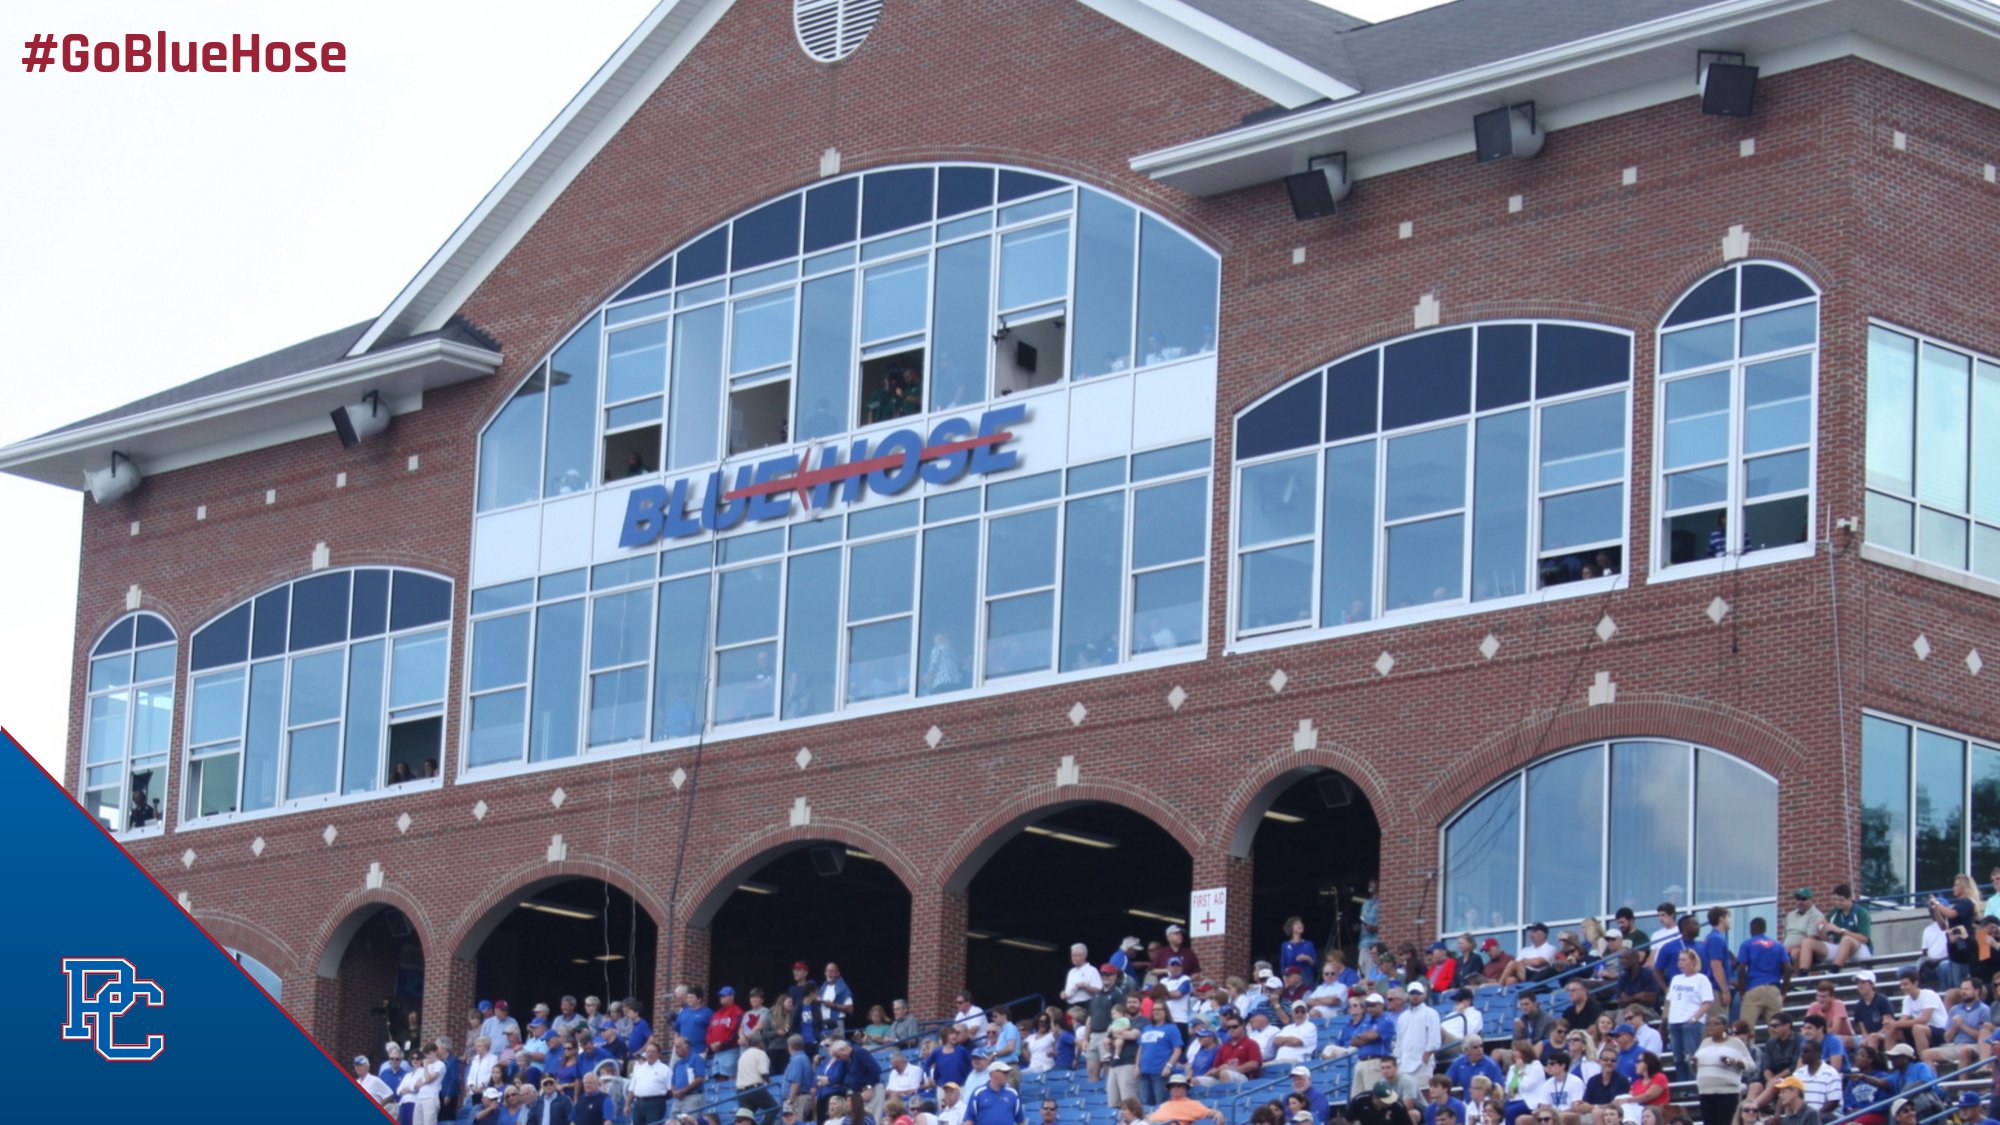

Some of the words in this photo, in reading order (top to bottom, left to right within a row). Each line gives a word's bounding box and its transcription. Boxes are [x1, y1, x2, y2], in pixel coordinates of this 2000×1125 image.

[619, 454, 799, 547] BLUE
[811, 404, 1027, 508] HOSE
[1193, 893, 1211, 909] FIRST
[1213, 891, 1225, 906] AID
